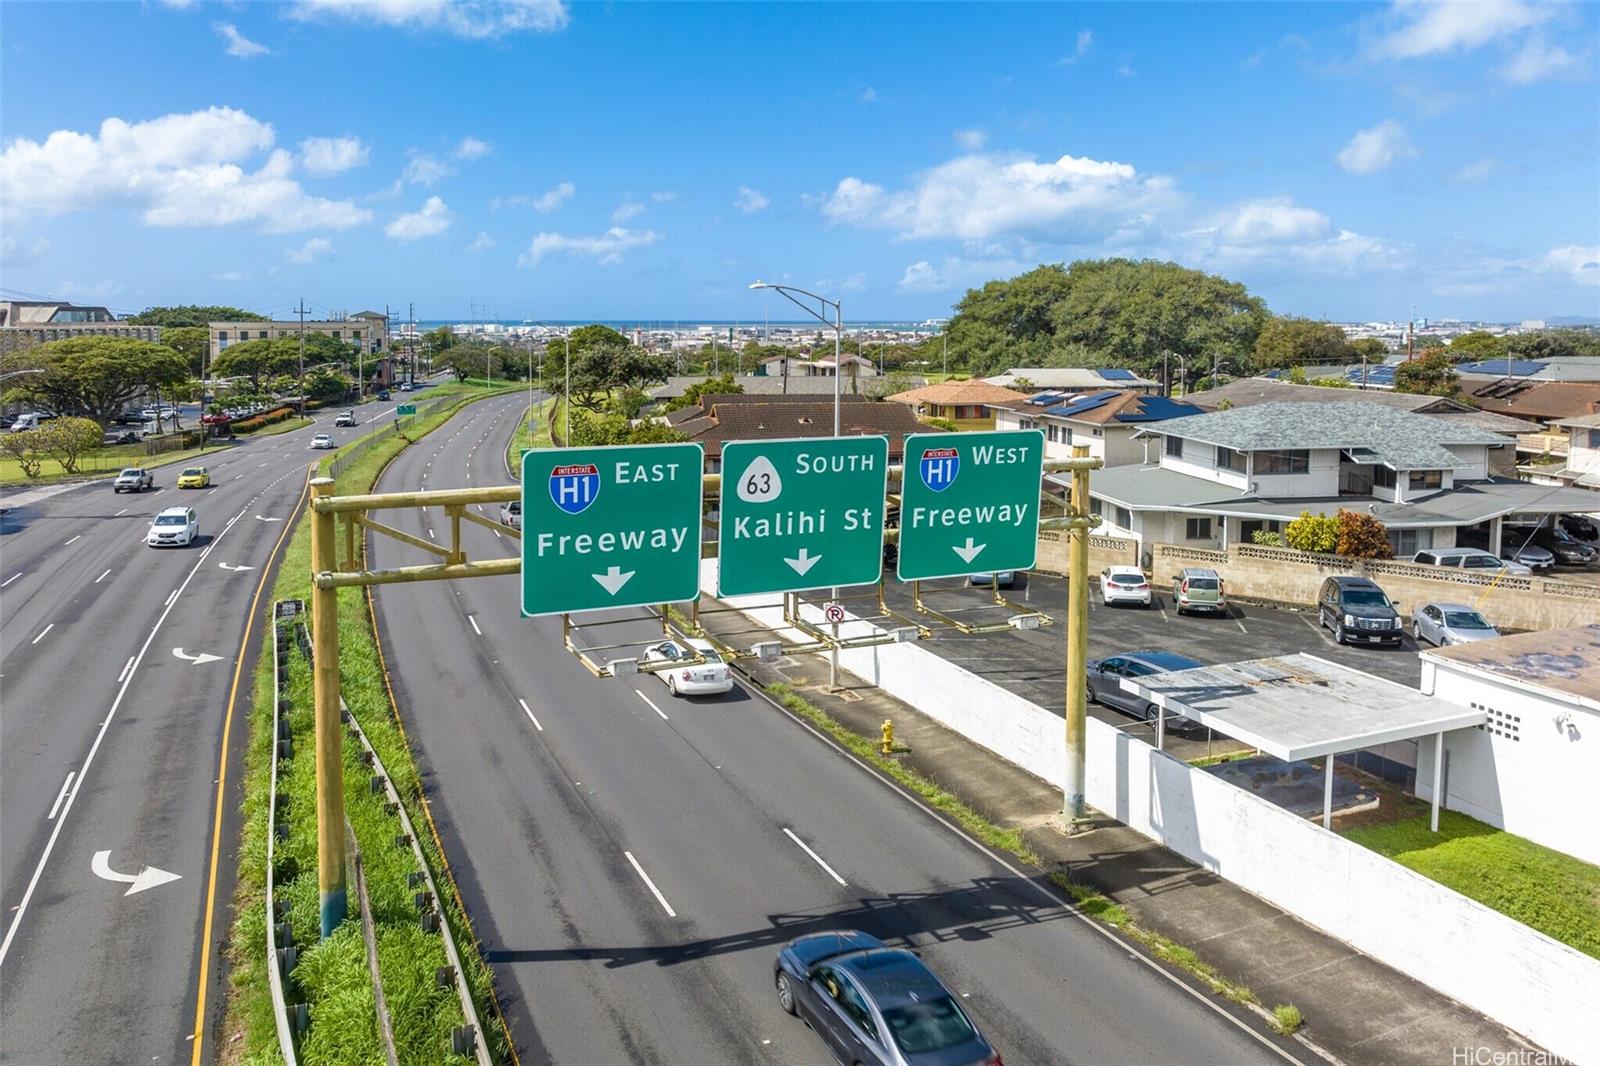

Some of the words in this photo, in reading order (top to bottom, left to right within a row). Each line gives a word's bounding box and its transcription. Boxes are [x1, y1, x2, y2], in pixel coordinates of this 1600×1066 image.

[796, 453, 874, 474] SOUTH
[926, 449, 954, 458] INTERSTATE
[972, 445, 1029, 465] WEST
[557, 465, 593, 475] INTERSTATE
[615, 461, 680, 484] EAST
[927, 459, 952, 484] H1
[559, 476, 590, 505] H1
[746, 473, 771, 495] 63
[734, 509, 825, 539] Kalihi
[843, 508, 872, 530] St
[912, 503, 1029, 529] Freeway
[537, 526, 689, 557] Freeway
